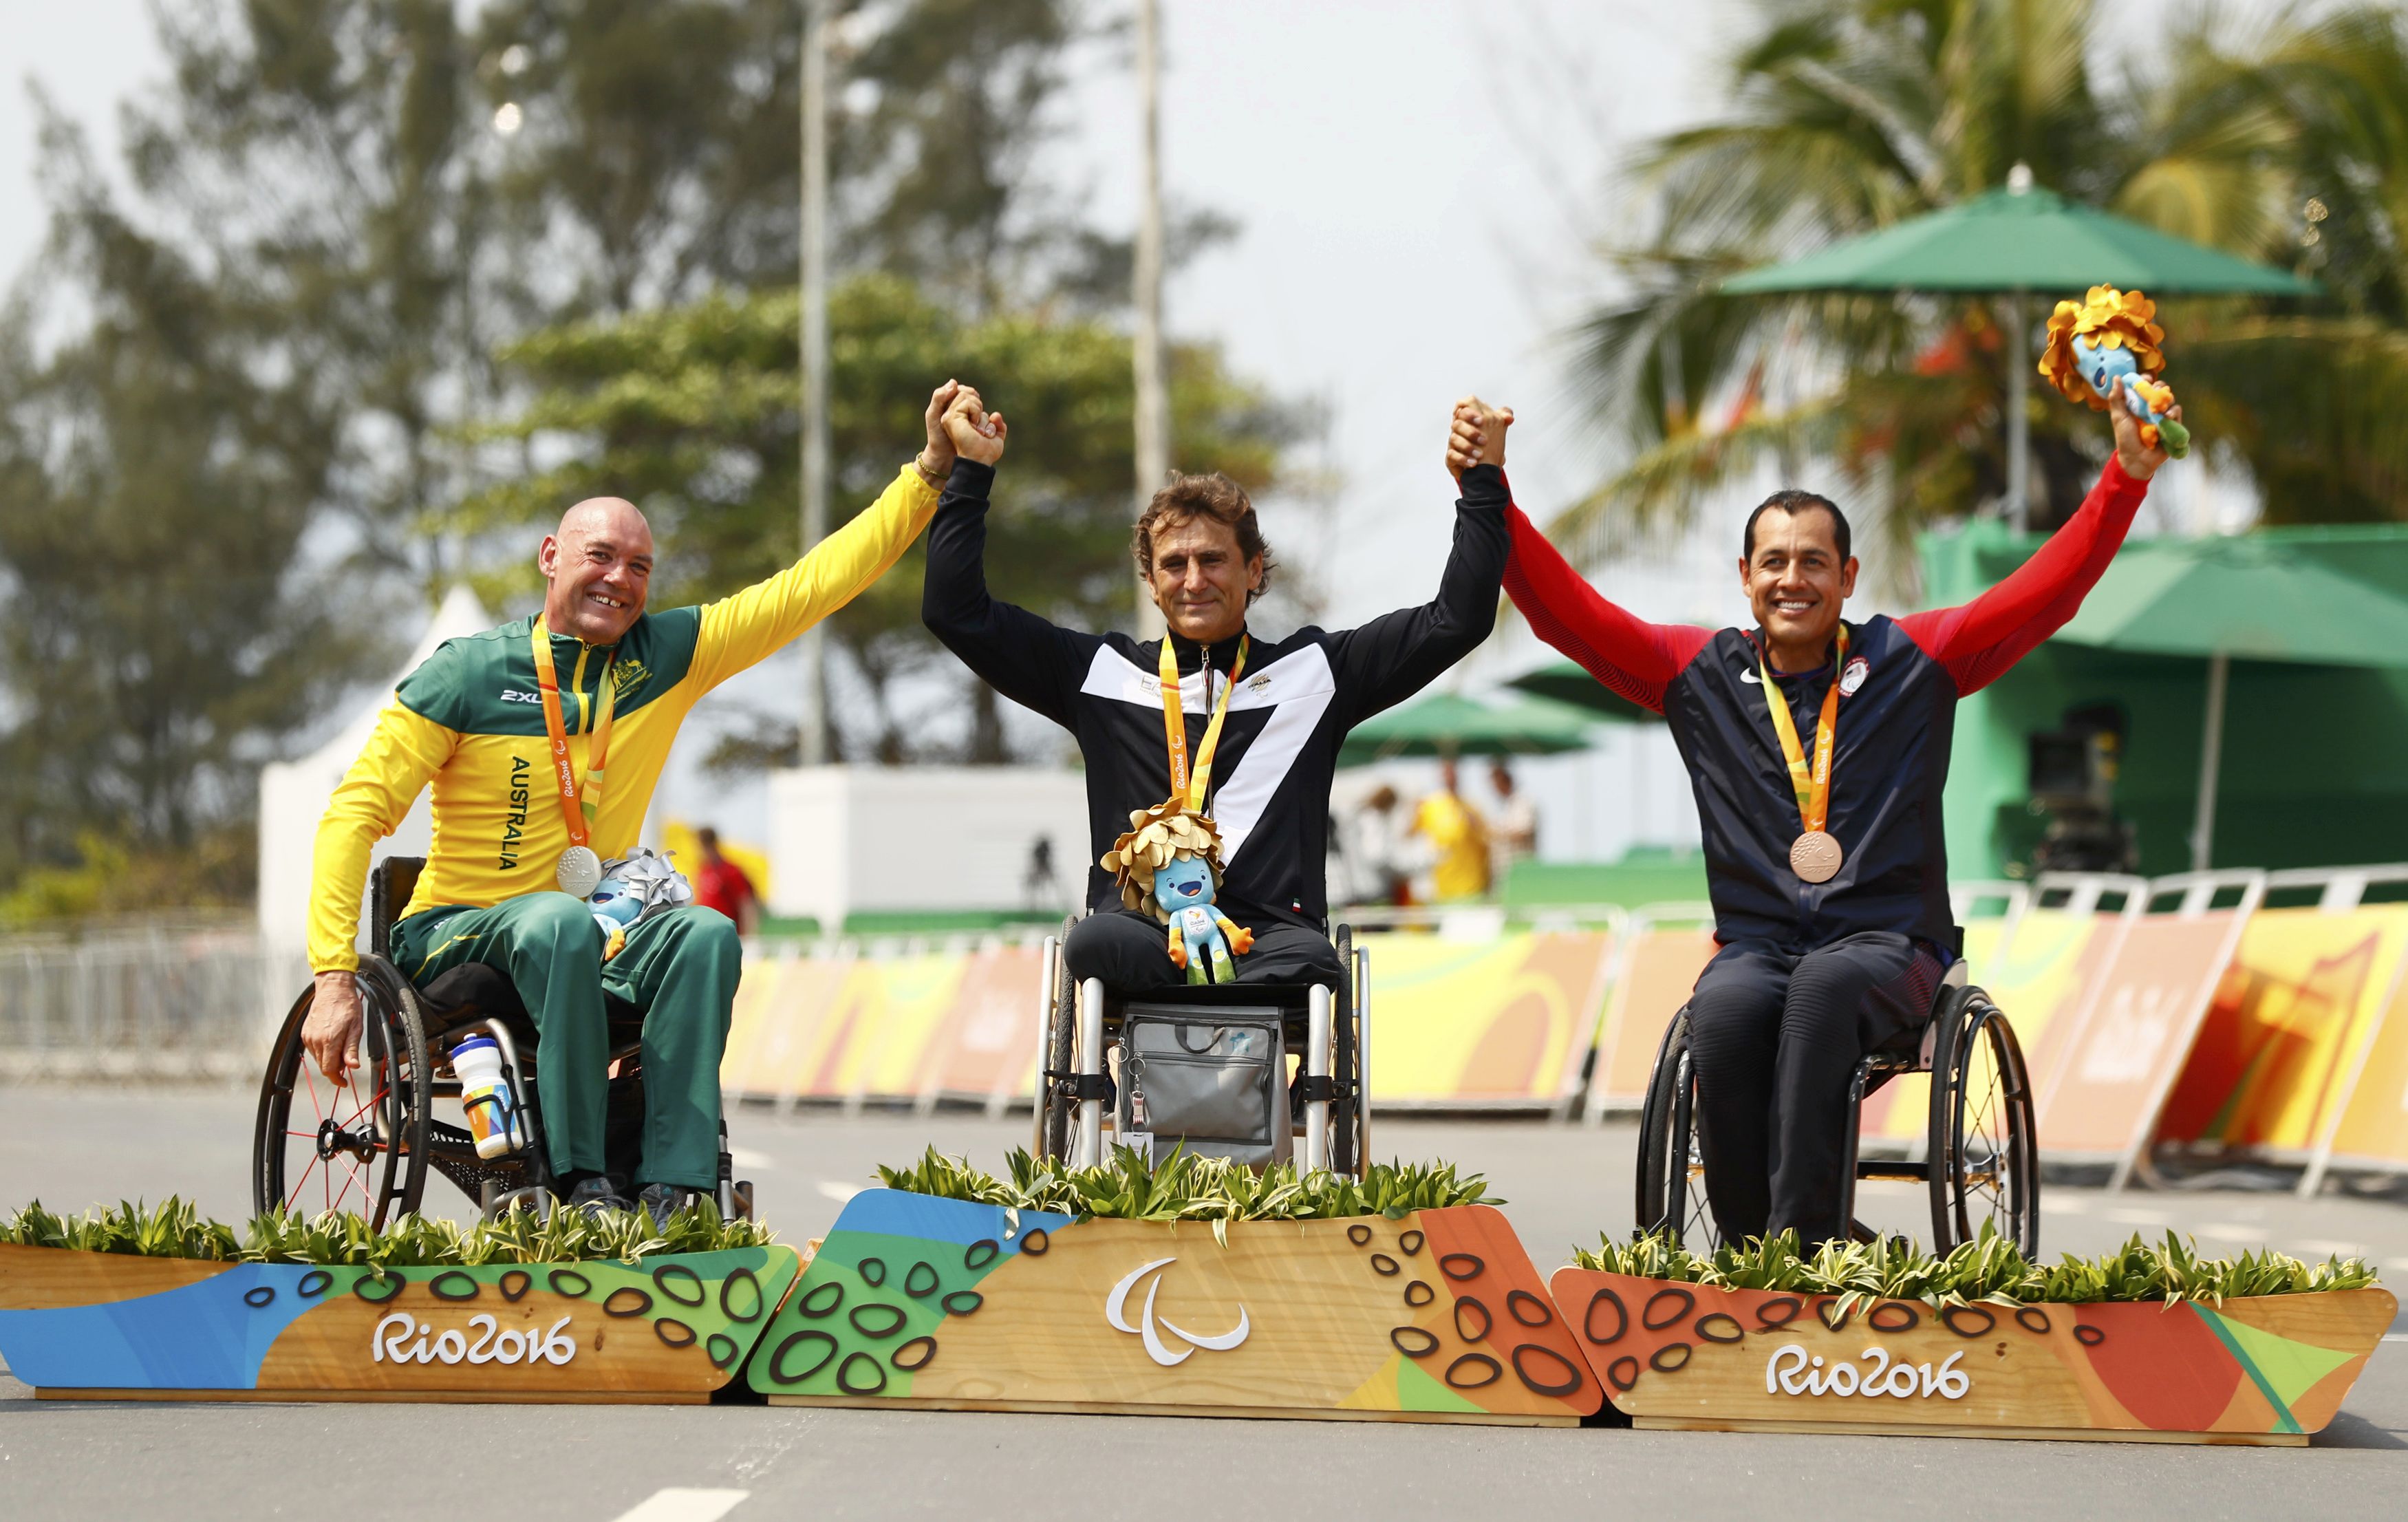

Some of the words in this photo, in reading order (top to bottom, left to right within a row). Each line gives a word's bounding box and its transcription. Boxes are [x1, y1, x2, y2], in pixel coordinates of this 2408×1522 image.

[559, 760, 574, 797] Rio2016
[1174, 753, 1185, 789] Rio2016
[1816, 748, 1828, 784] Rio2016
[499, 756, 530, 870] AUSTRALIA
[373, 1313, 577, 1365] Rio2016
[1766, 1344, 1970, 1400] Rio2016
